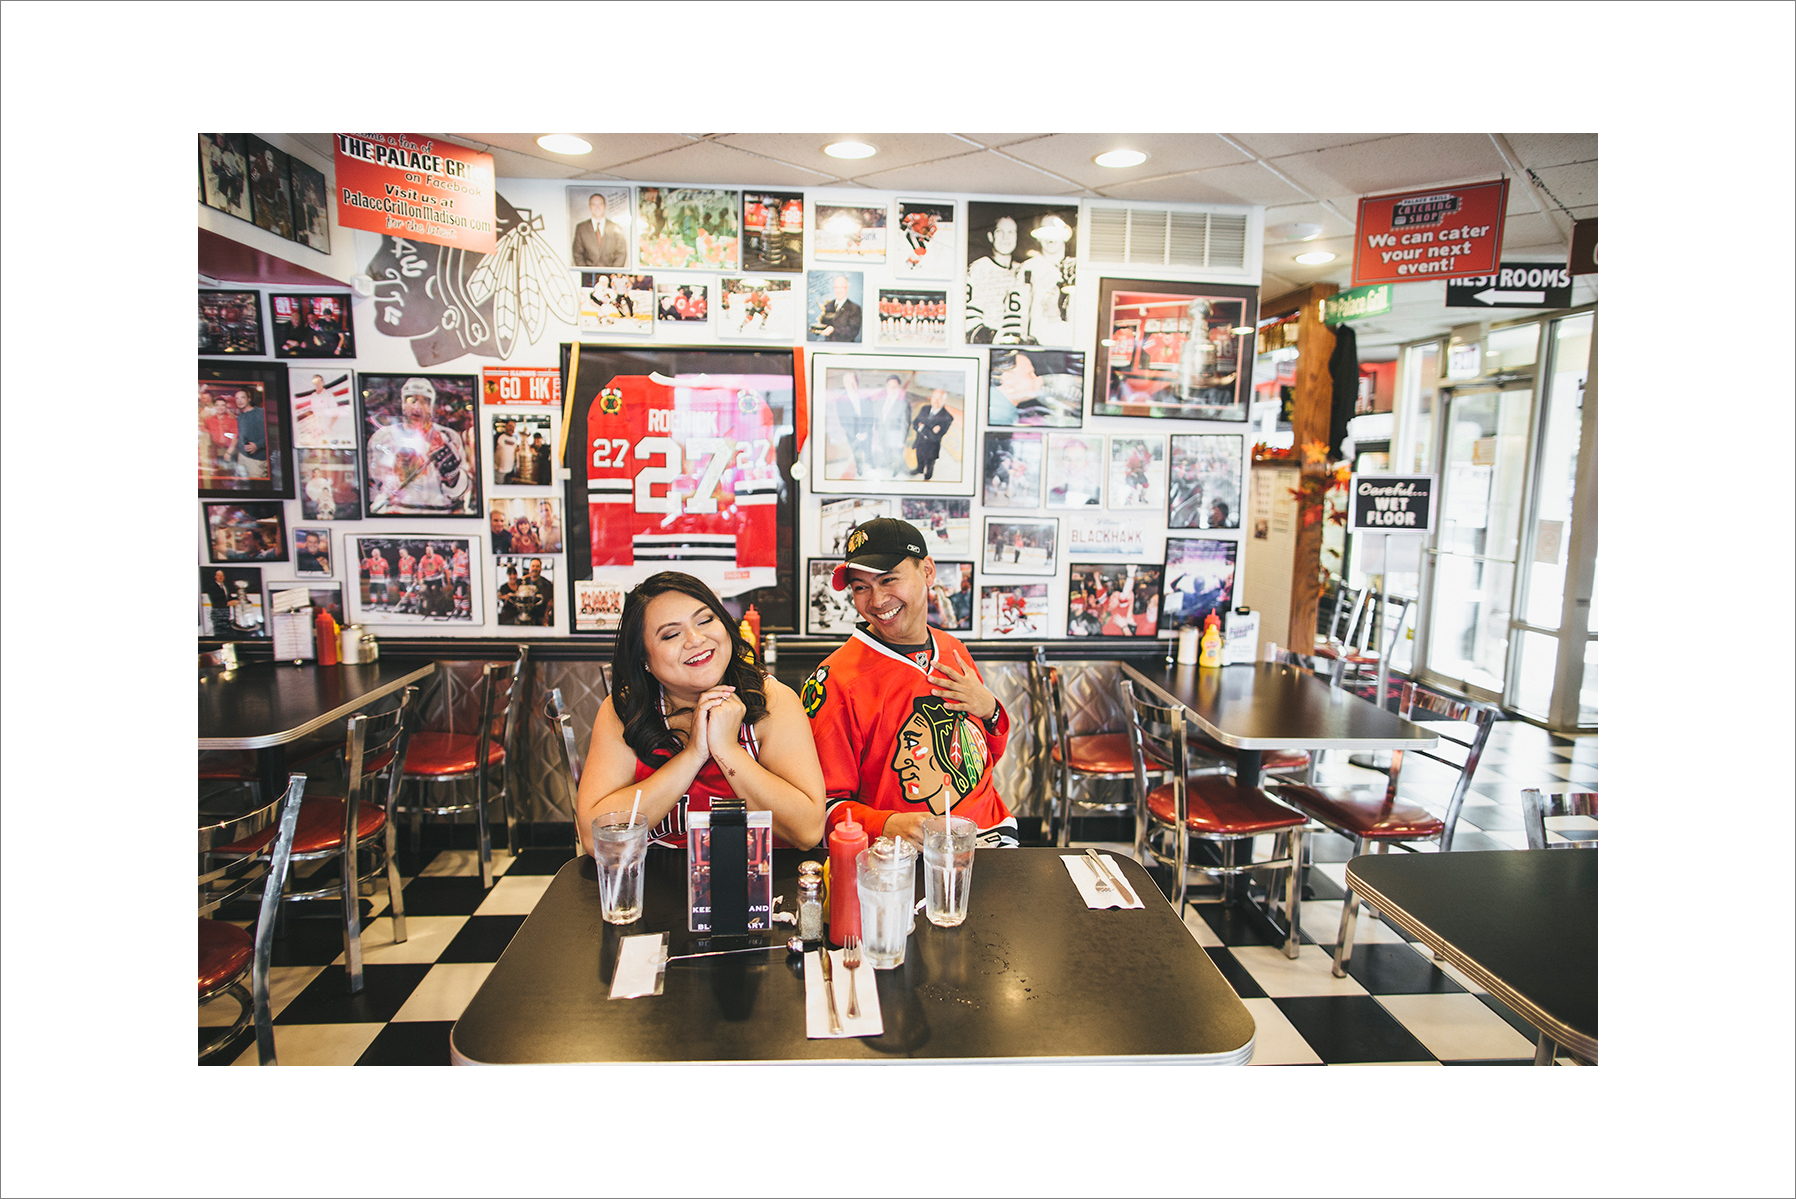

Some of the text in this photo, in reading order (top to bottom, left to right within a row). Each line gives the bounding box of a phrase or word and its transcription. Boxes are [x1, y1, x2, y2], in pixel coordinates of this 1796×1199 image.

[388, 136, 397, 145] a
[399, 134, 419, 150] fan
[421, 141, 433, 154] of
[337, 133, 489, 184] THE PALACE GRI
[385, 184, 453, 207] Visit us at
[405, 172, 482, 197] on Facebook
[342, 188, 491, 233] PalaceGrillonMadison.com
[1398, 201, 1452, 215] CATERING
[1409, 213, 1438, 224] SHOP
[386, 216, 402, 229] for
[406, 219, 424, 233] the
[1367, 224, 1490, 249] We can cater
[1380, 240, 1472, 264] your next
[1397, 256, 1455, 275] event!
[500, 377, 521, 400] GO
[529, 377, 550, 400] HK
[593, 438, 630, 468] 27
[735, 439, 771, 471] 27
[634, 436, 734, 514] 27
[1375, 497, 1410, 511] WET
[1366, 510, 1416, 526] FLOOR
[1071, 529, 1142, 543] BLACKHAWK
[692, 906, 711, 914] KEE
